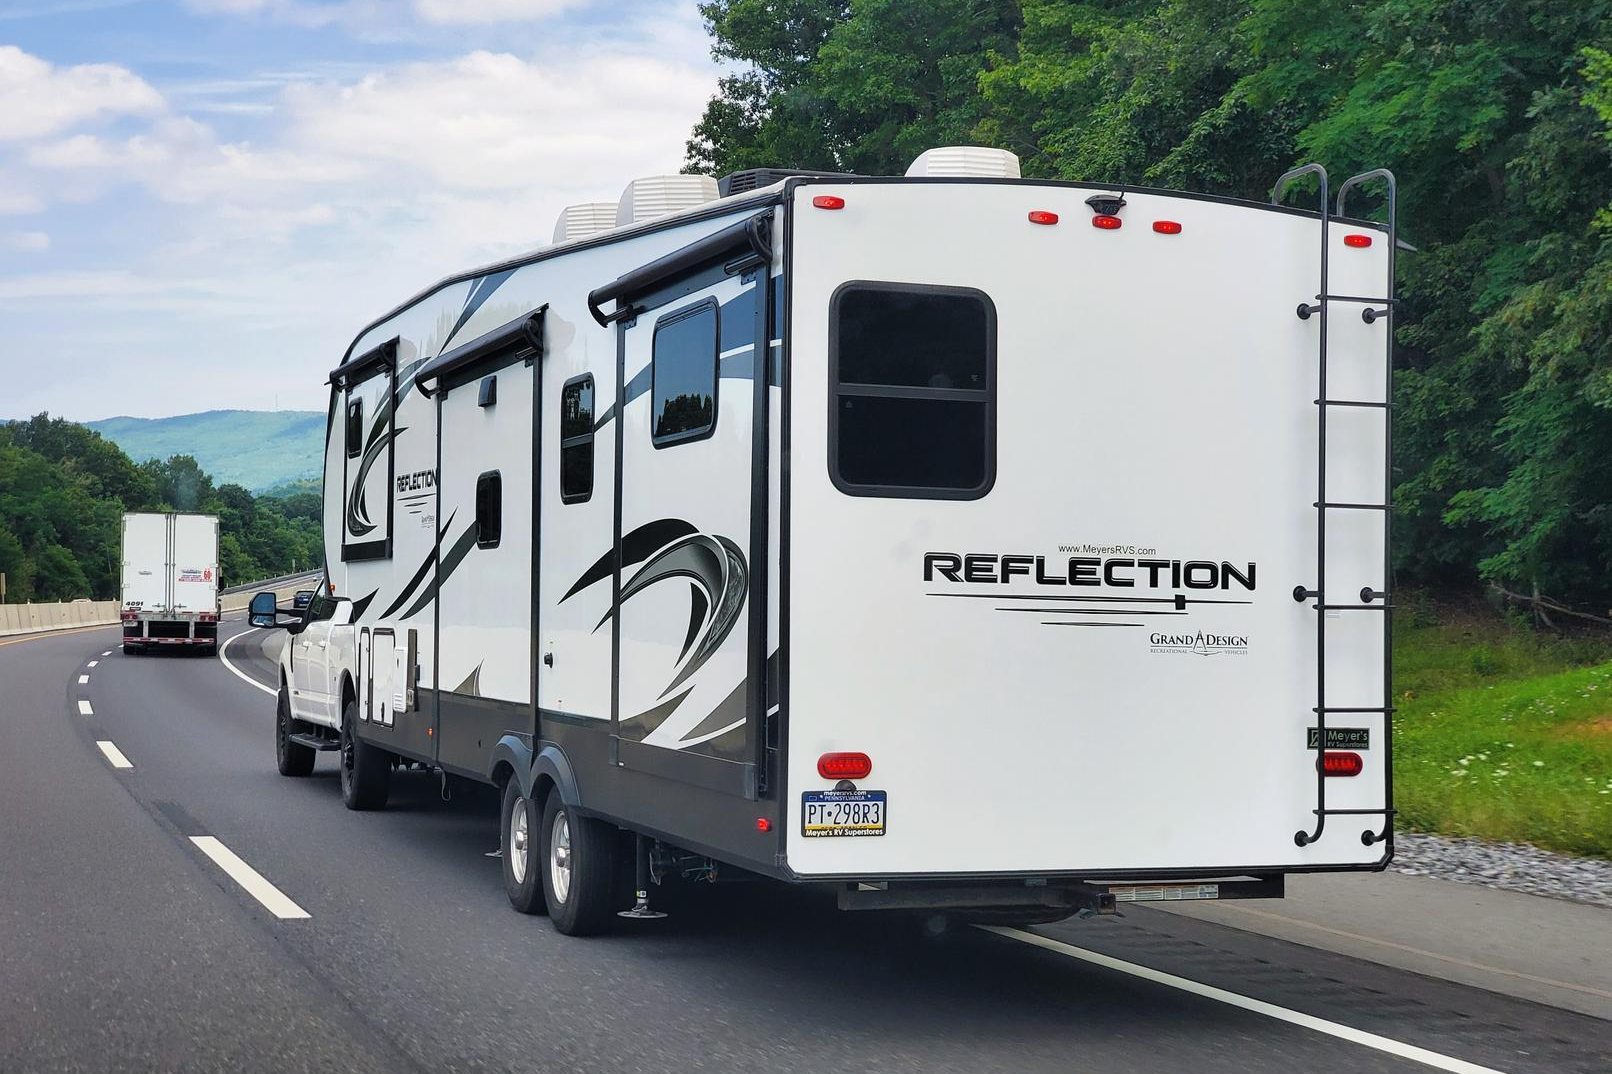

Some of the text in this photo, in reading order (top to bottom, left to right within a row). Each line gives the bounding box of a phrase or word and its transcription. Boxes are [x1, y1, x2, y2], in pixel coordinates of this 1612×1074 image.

[1058, 544, 1156, 556] www.MeyersRVS.com
[923, 551, 1256, 591] REFLECTION
[1150, 632, 1248, 646] GRAND DESIGN
[1328, 730, 1368, 742] Meyer's
